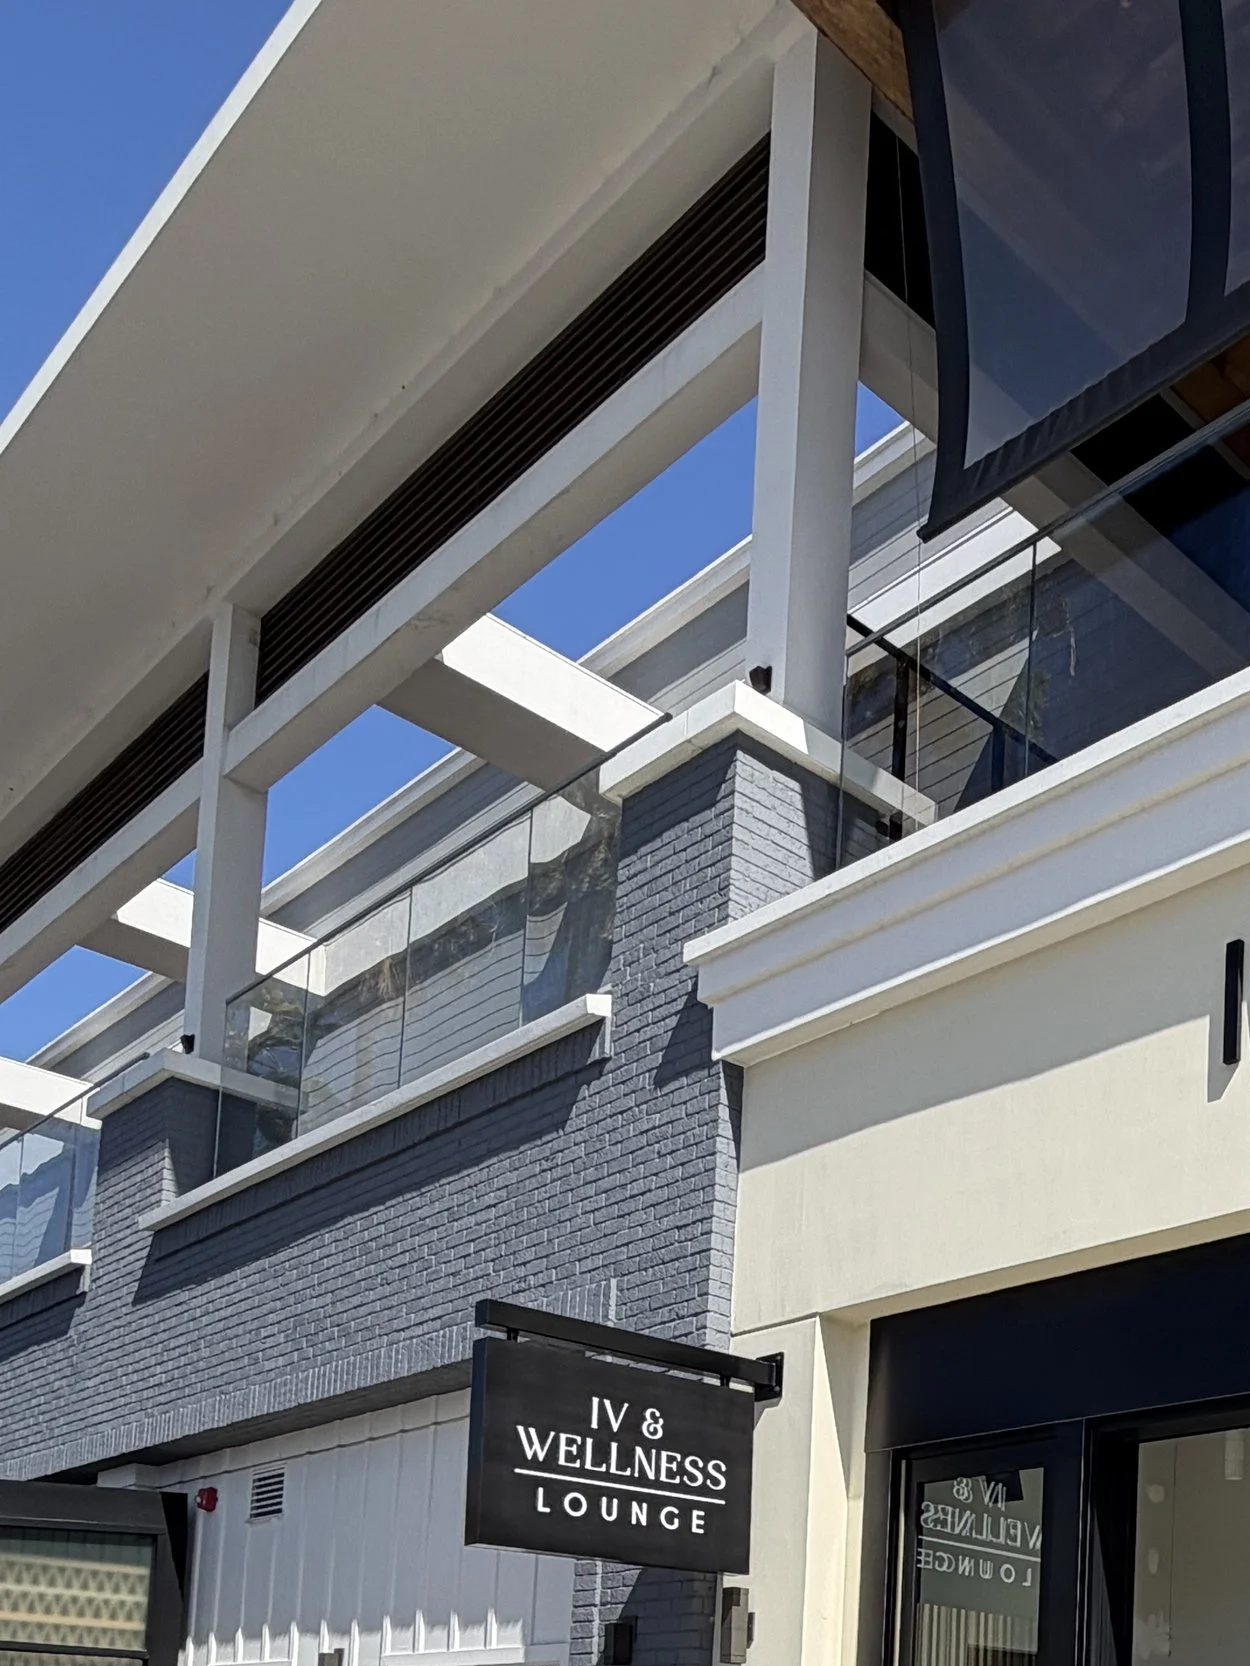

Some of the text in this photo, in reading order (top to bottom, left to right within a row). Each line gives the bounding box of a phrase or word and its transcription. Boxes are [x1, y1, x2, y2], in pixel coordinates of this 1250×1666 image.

[590, 1396, 664, 1440] IV &
[516, 1424, 727, 1491] WELLNESS
[537, 1487, 705, 1534] LOUNGE
